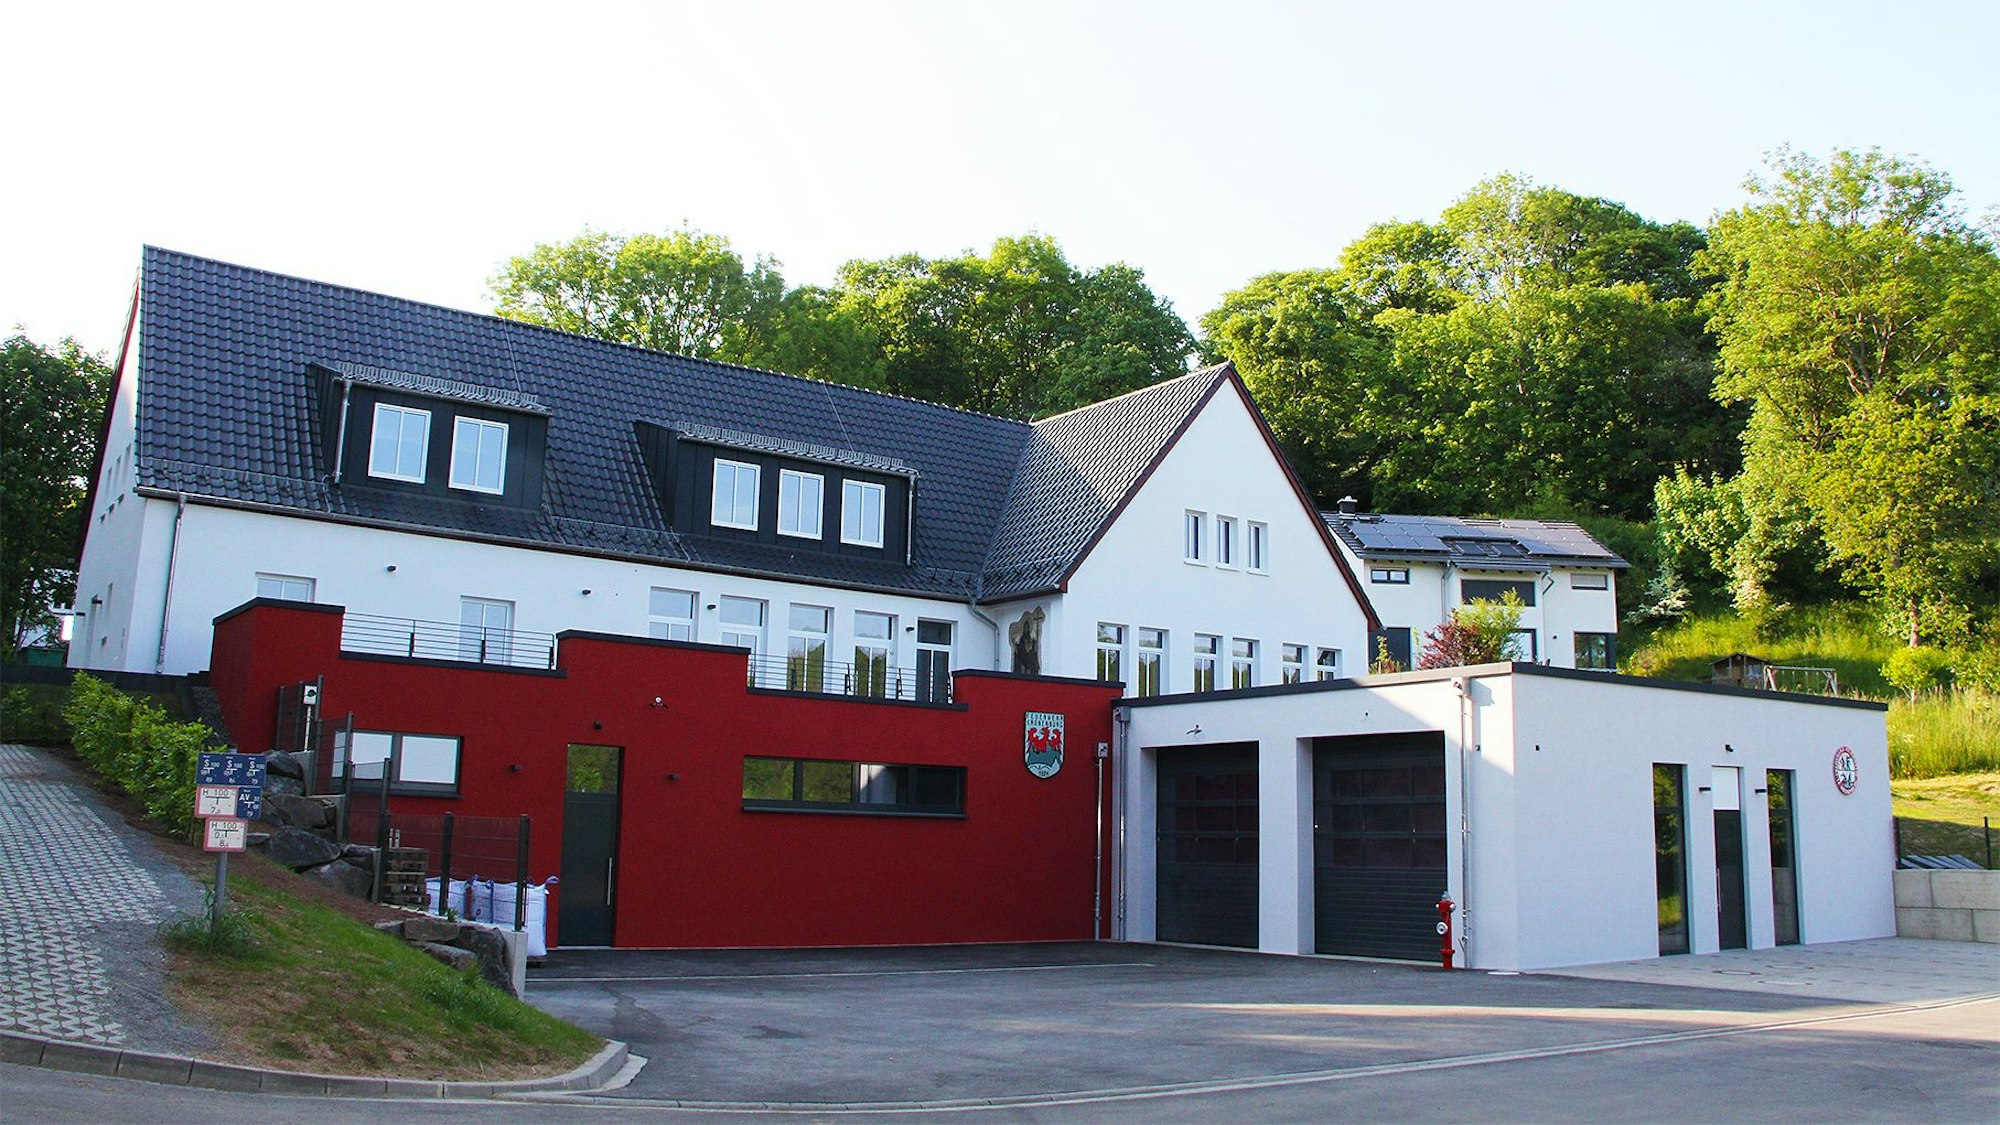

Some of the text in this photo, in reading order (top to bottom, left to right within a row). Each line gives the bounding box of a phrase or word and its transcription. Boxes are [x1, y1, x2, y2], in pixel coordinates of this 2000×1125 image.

[204, 759, 210, 767] S
[227, 760, 233, 768] S
[249, 761, 255, 769] S
[239, 793, 250, 801] AV
